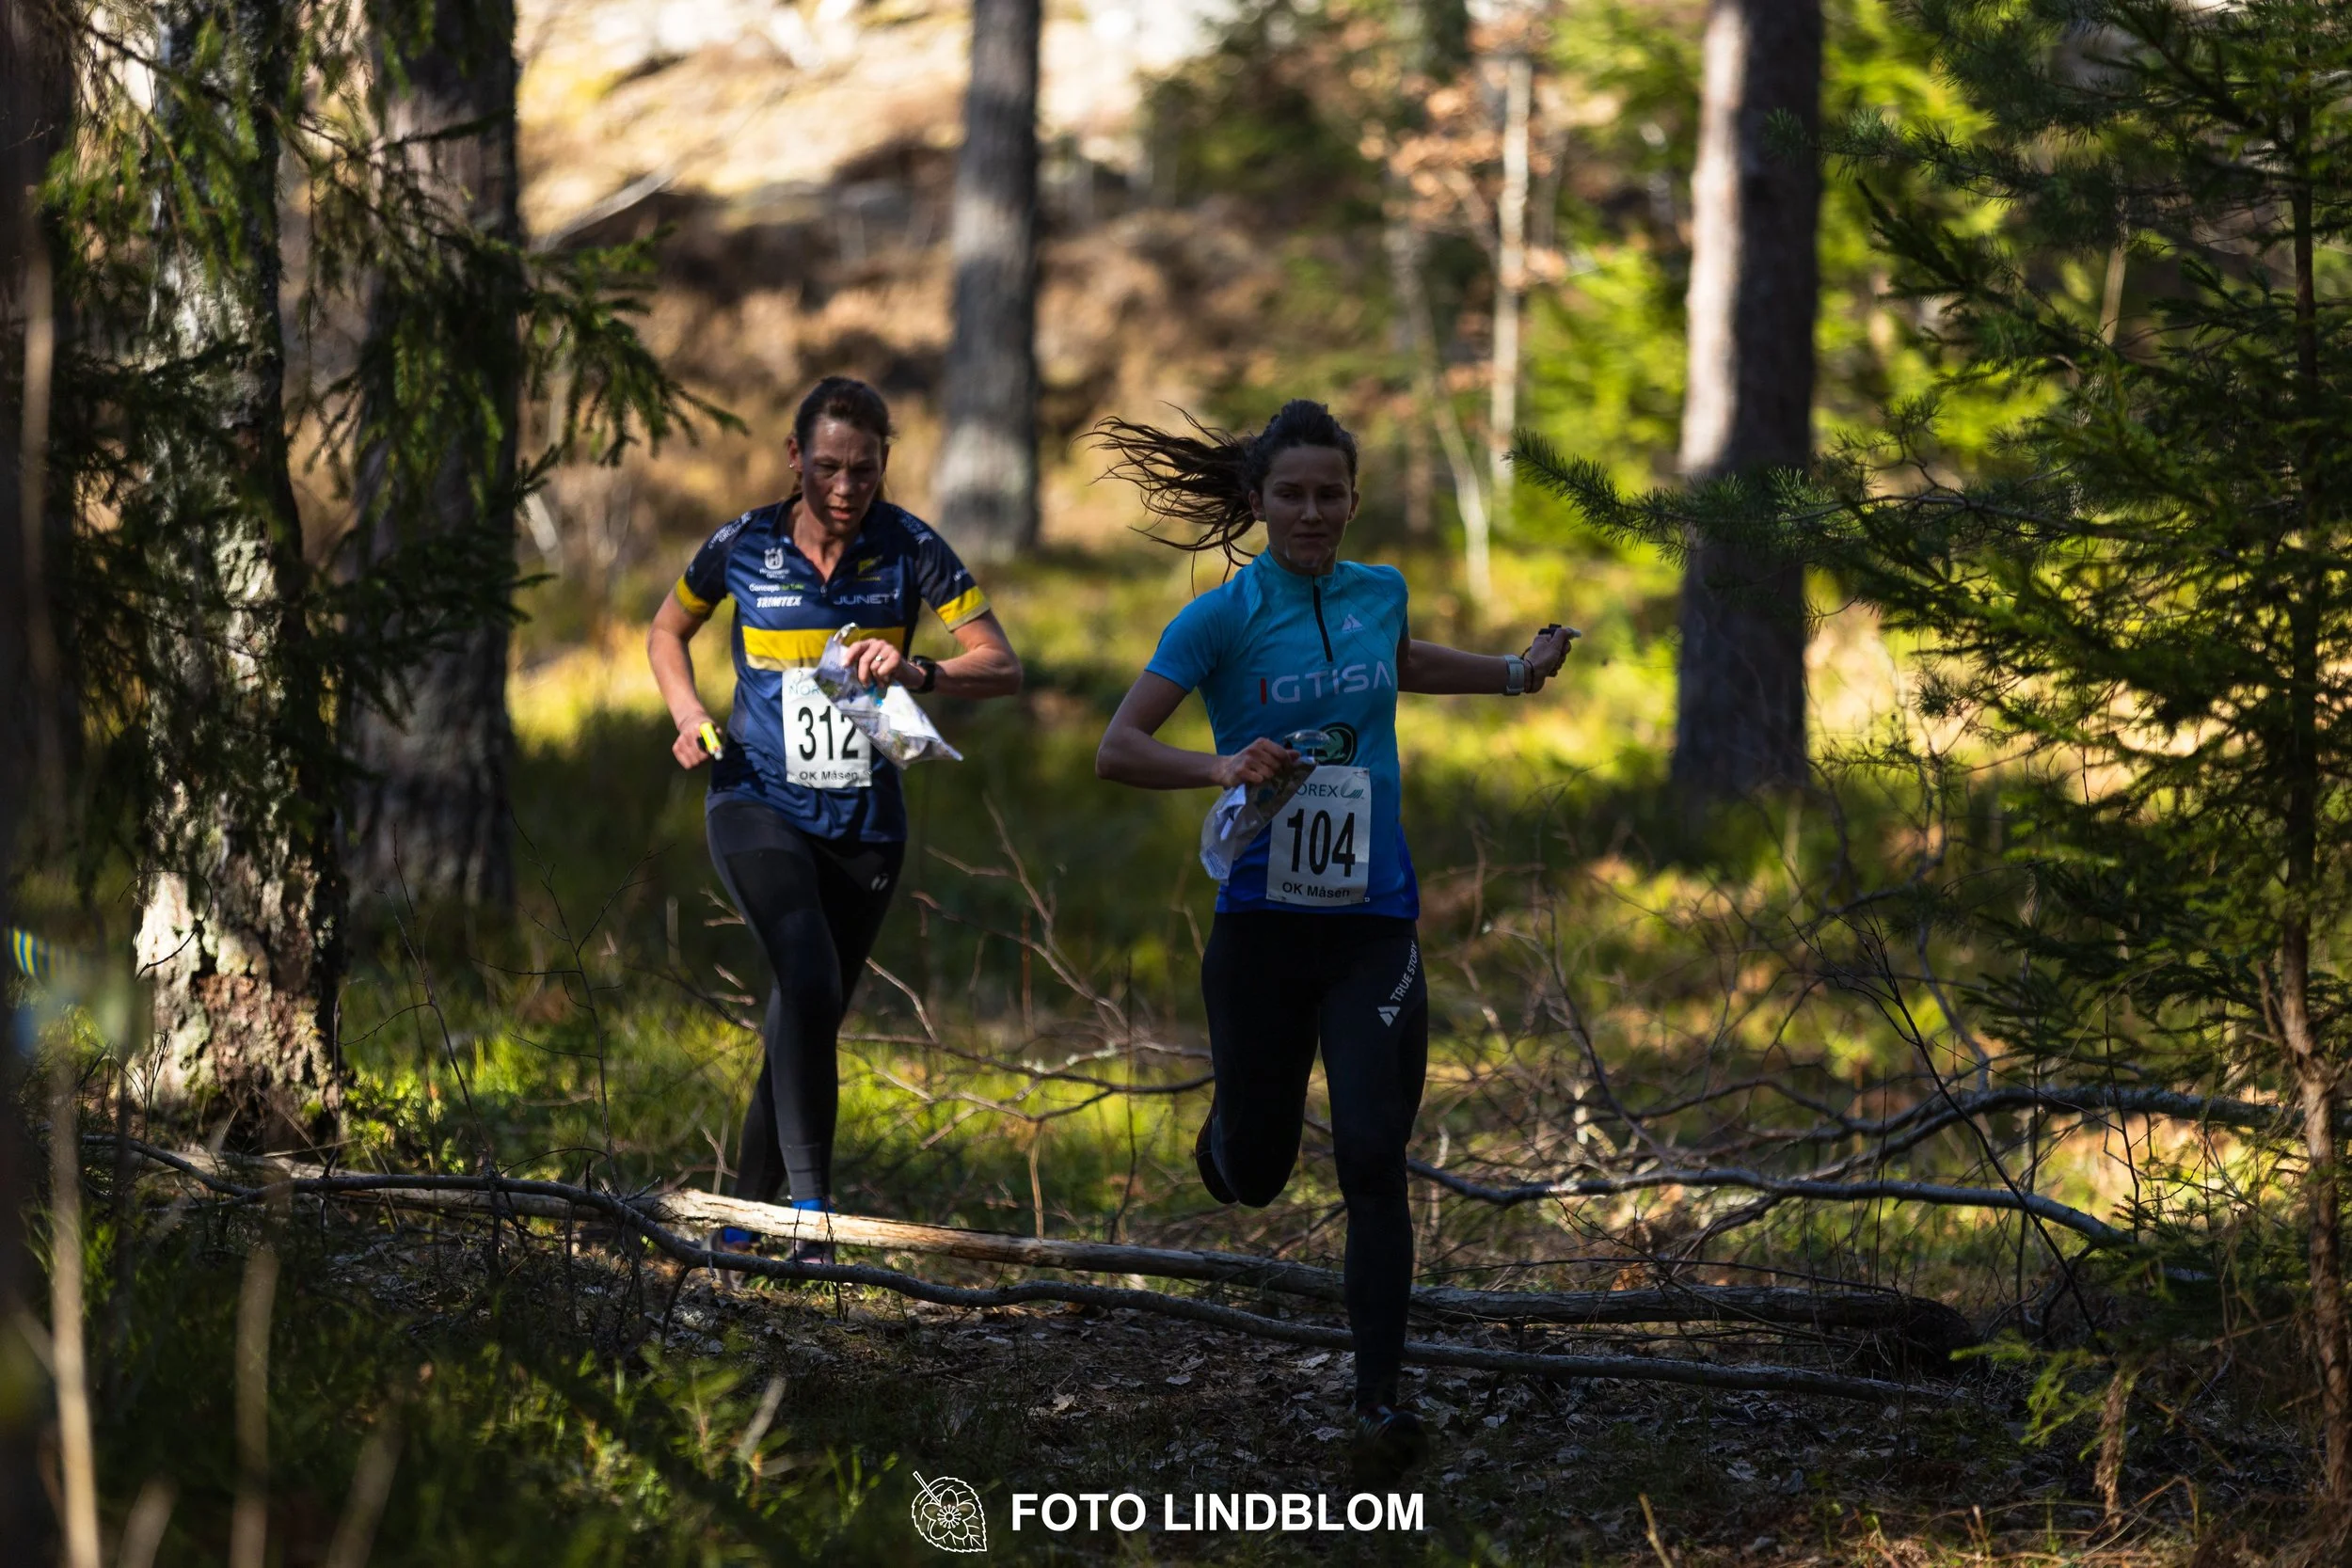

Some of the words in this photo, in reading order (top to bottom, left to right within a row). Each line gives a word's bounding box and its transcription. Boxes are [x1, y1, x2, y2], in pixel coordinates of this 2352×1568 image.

[756, 595, 803, 608] TRIMTEX
[834, 594, 890, 605] JUNET
[789, 685, 819, 695] NOR
[1261, 660, 1392, 705] IGTISA
[798, 705, 859, 762] 312
[799, 771, 818, 781] OK
[821, 770, 859, 781] Måsen
[1296, 784, 1338, 798] OREX
[1287, 809, 1355, 877] 104
[1282, 882, 1303, 895] OK
[1307, 885, 1350, 898] Måsen
[1391, 973, 1413, 1001] TRUE
[1407, 941, 1418, 975] STORY
